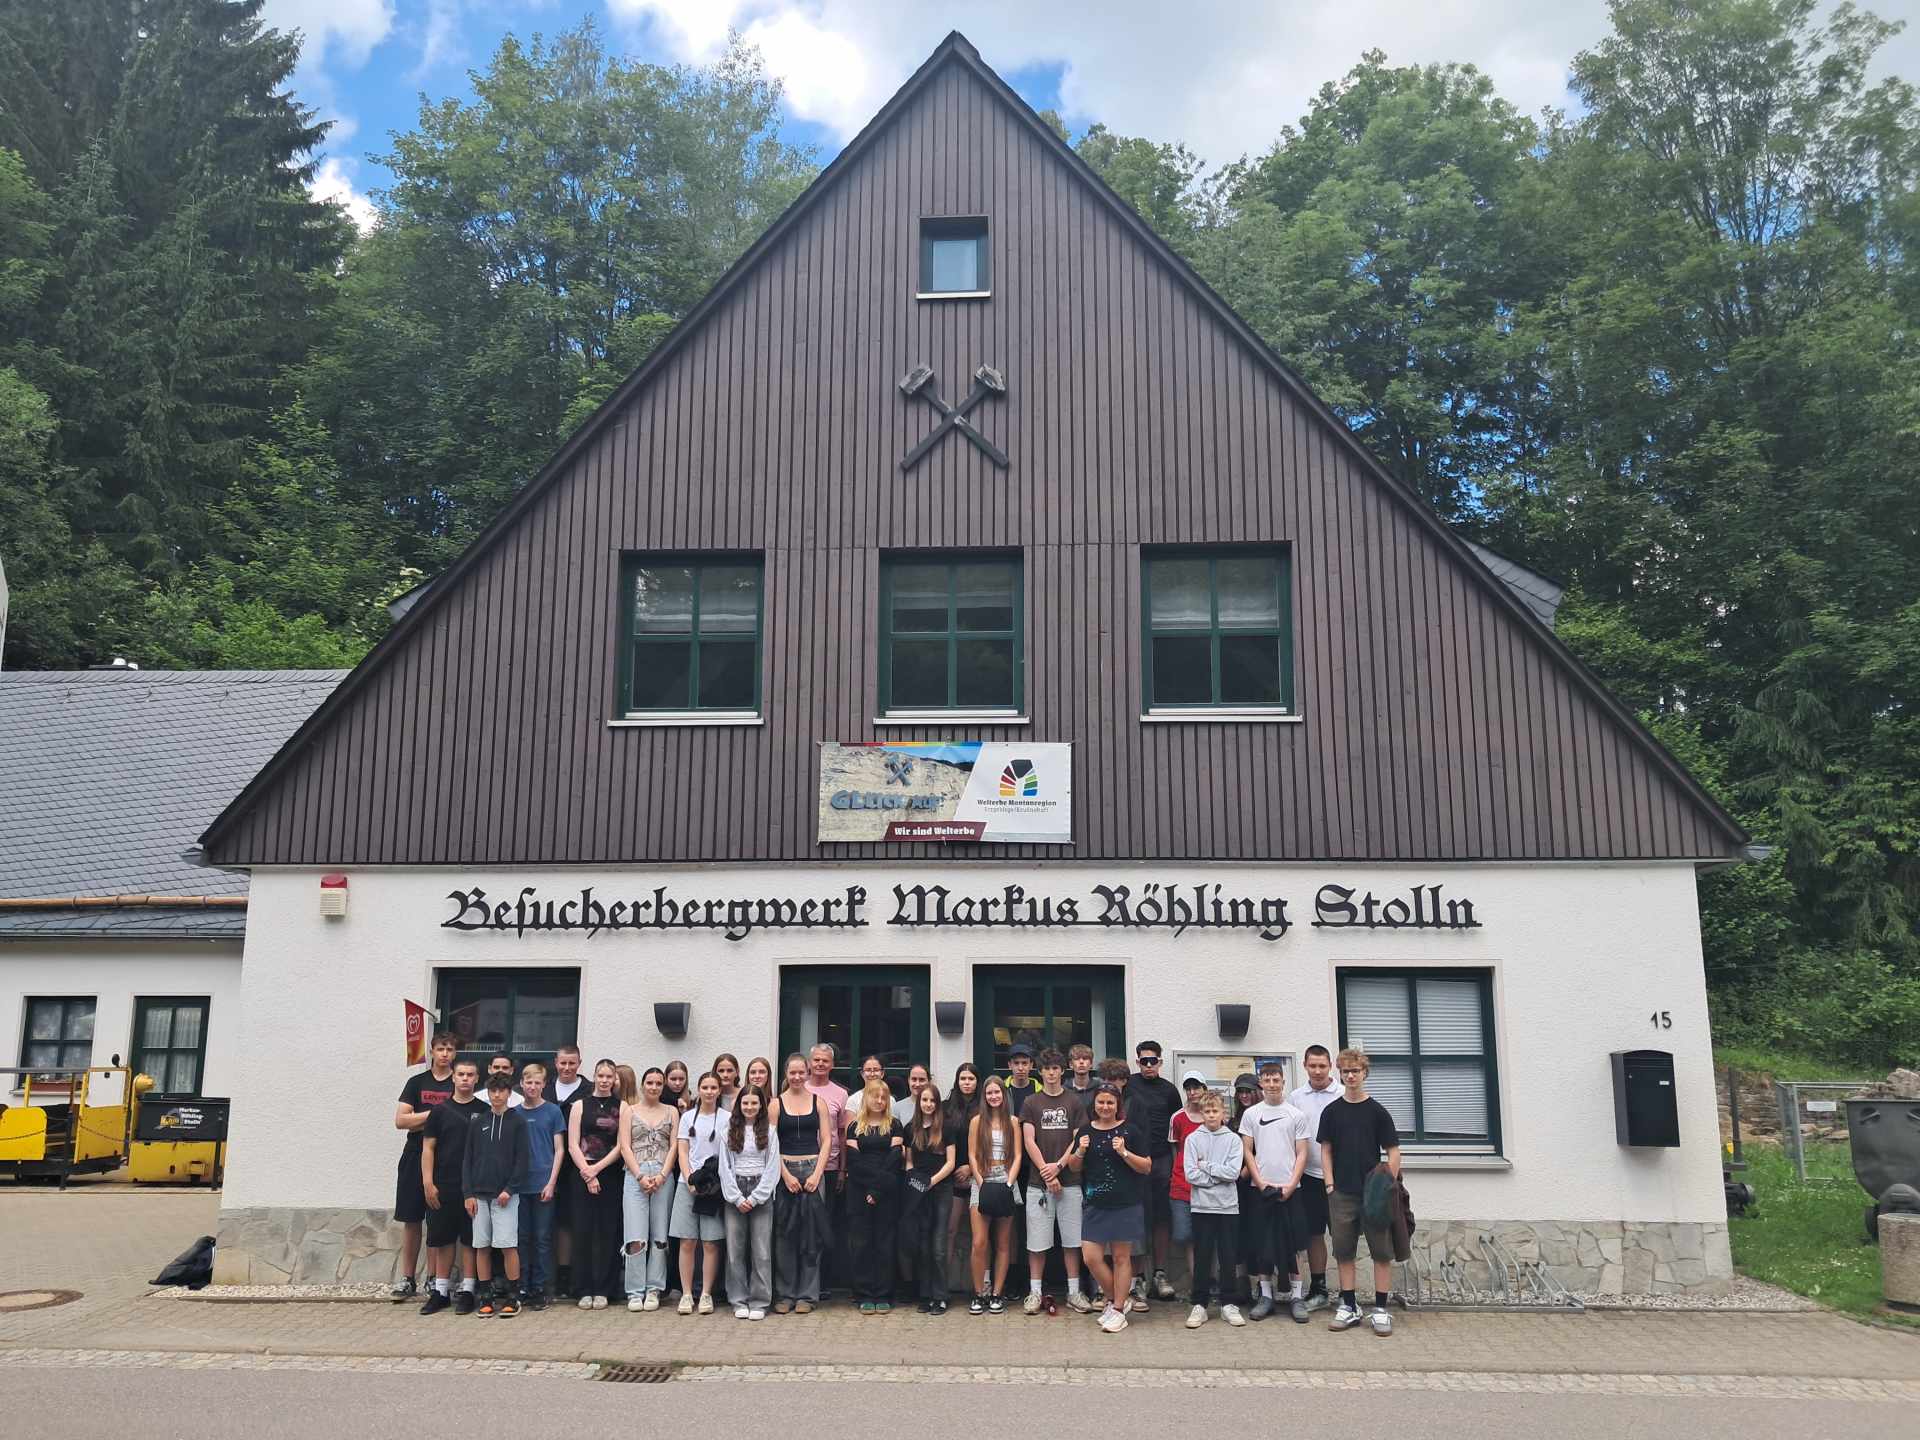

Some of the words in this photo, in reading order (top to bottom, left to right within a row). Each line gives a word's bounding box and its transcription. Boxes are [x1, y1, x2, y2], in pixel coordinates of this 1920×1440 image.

[894, 826, 911, 836] Wir
[912, 826, 932, 836] sind
[933, 826, 975, 836] Welterbe
[887, 884, 1079, 927] Markus
[1091, 884, 1293, 941] Röhling
[1311, 884, 1482, 930] Stolln
[1651, 1011, 1672, 1029] 15
